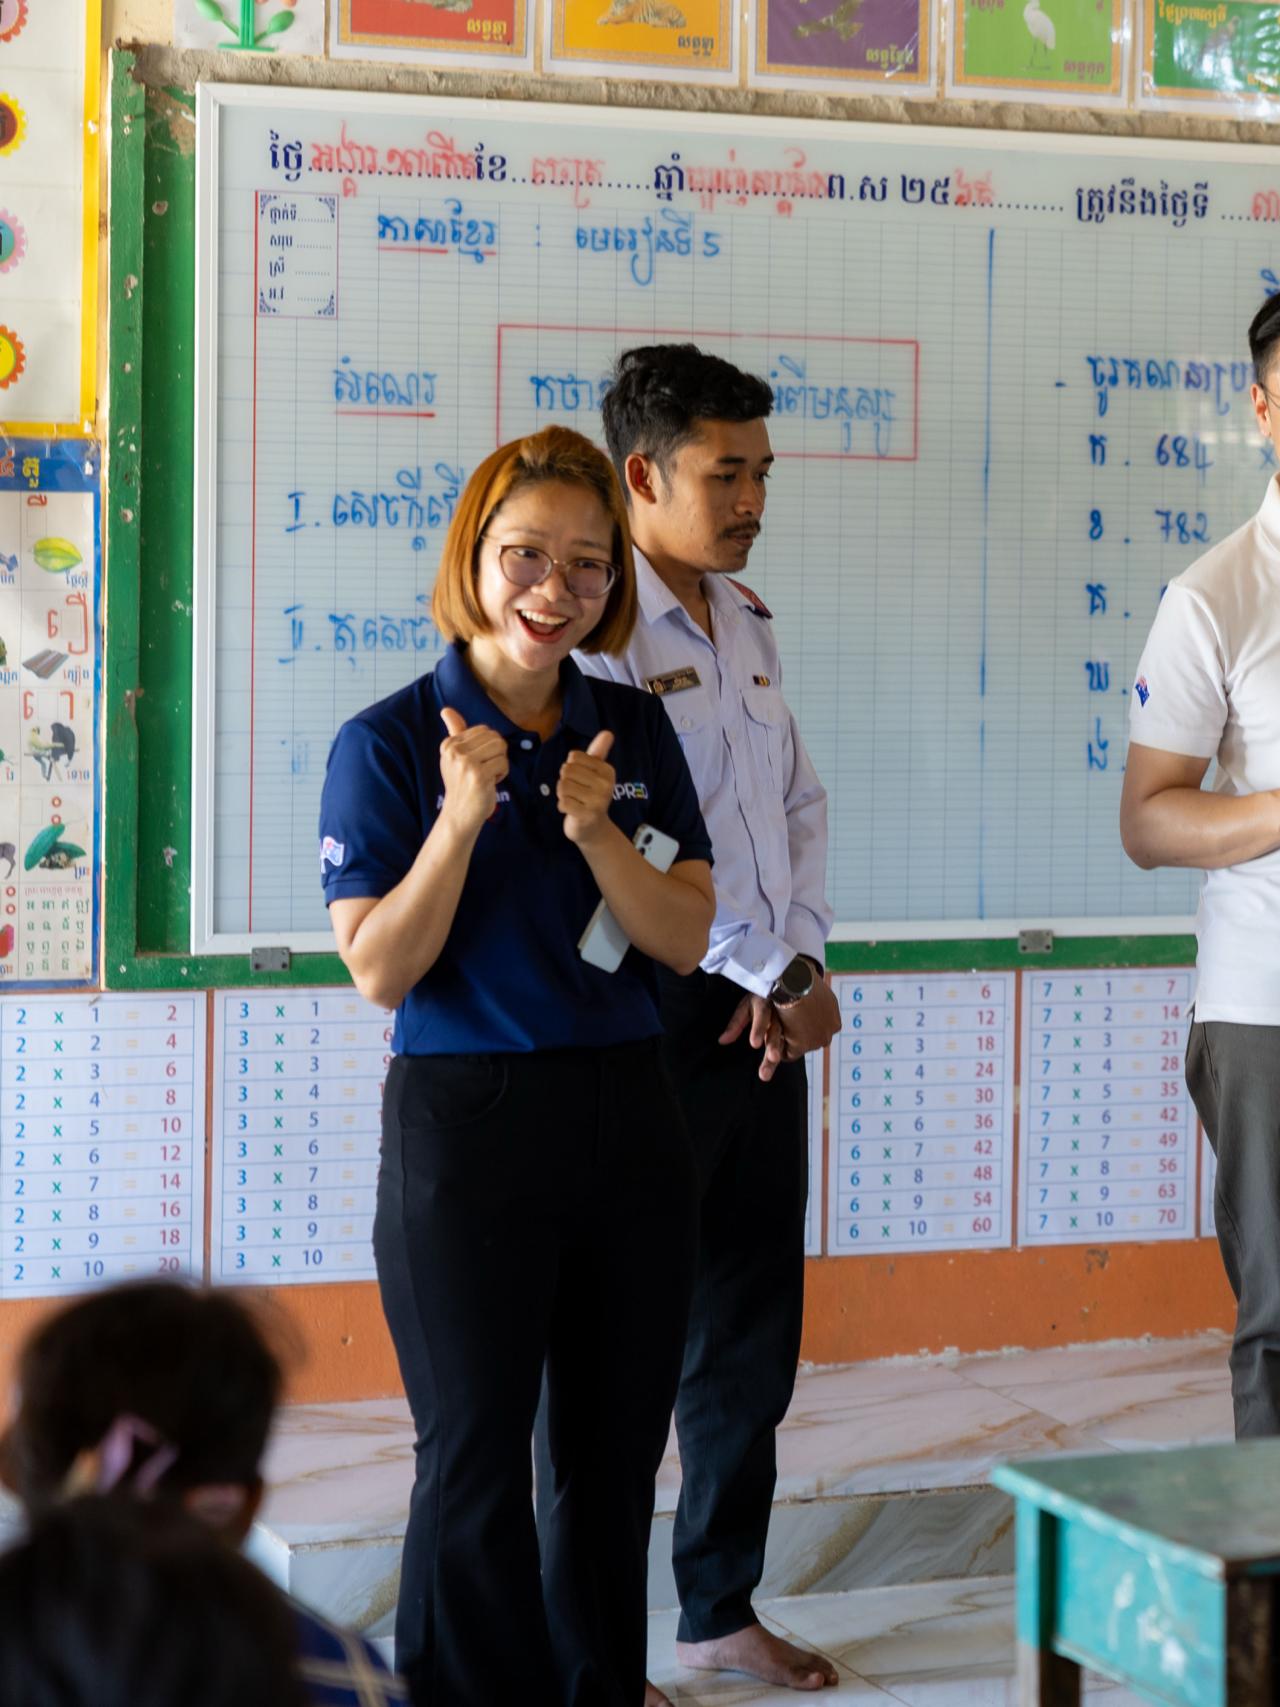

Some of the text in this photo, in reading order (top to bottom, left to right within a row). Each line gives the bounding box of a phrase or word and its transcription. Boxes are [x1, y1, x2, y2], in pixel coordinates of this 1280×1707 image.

[270, 129, 302, 182] ថ្ងៃ
[475, 142, 507, 181] ខែ
[852, 987, 864, 1002] 6
[917, 985, 924, 1001] 1
[980, 984, 991, 1000] 6
[16, 1008, 27, 1025] 2
[92, 1007, 99, 1023] 1
[167, 1004, 177, 1022] 2
[1043, 1007, 1053, 1024] 7
[1103, 1006, 1113, 1022] 2
[1163, 1004, 1180, 1020] 14
[239, 1029, 249, 1047] 3
[310, 1028, 320, 1045] 2
[851, 1040, 862, 1056] 6
[915, 1037, 925, 1054] 3
[977, 1035, 995, 1052] 18
[15, 1065, 26, 1082] 2
[90, 1063, 100, 1080] 3
[165, 1061, 177, 1078] 6
[239, 1058, 249, 1074] 3
[310, 1055, 320, 1073] 3
[1042, 1059, 1052, 1075] 7
[1102, 1057, 1112, 1073] 4
[1161, 1055, 1180, 1072] 28
[851, 1092, 862, 1108] 6
[914, 1089, 925, 1106] 5
[975, 1087, 994, 1104] 30
[1041, 1110, 1051, 1127] 7
[1101, 1108, 1112, 1125] 6
[1159, 1106, 1179, 1122] 42
[15, 1121, 26, 1139] 2
[89, 1119, 100, 1136] 5
[161, 1116, 182, 1134] 10
[238, 1141, 248, 1158] 3
[308, 1139, 319, 1156] 6
[850, 1145, 861, 1161] 6
[914, 1141, 924, 1158] 7
[973, 1139, 993, 1155] 42
[1040, 1161, 1049, 1178] 7
[1100, 1159, 1110, 1176] 8
[1159, 1157, 1178, 1174] 56
[14, 1178, 25, 1196] 2
[89, 1175, 100, 1192] 7
[160, 1172, 181, 1190] 14
[237, 1197, 247, 1213] 3
[307, 1194, 318, 1211] 8
[849, 1197, 860, 1213] 6
[913, 1194, 924, 1210] 9
[973, 1191, 993, 1207] 54
[1039, 1213, 1049, 1230] 7
[1096, 1210, 1114, 1227] 10
[1158, 1208, 1177, 1224] 70
[14, 1235, 25, 1253] 2
[88, 1232, 100, 1249] 9
[160, 1228, 181, 1246] 18
[14, 1263, 24, 1281] 2
[85, 1260, 104, 1277] 10
[157, 1256, 181, 1274] 20
